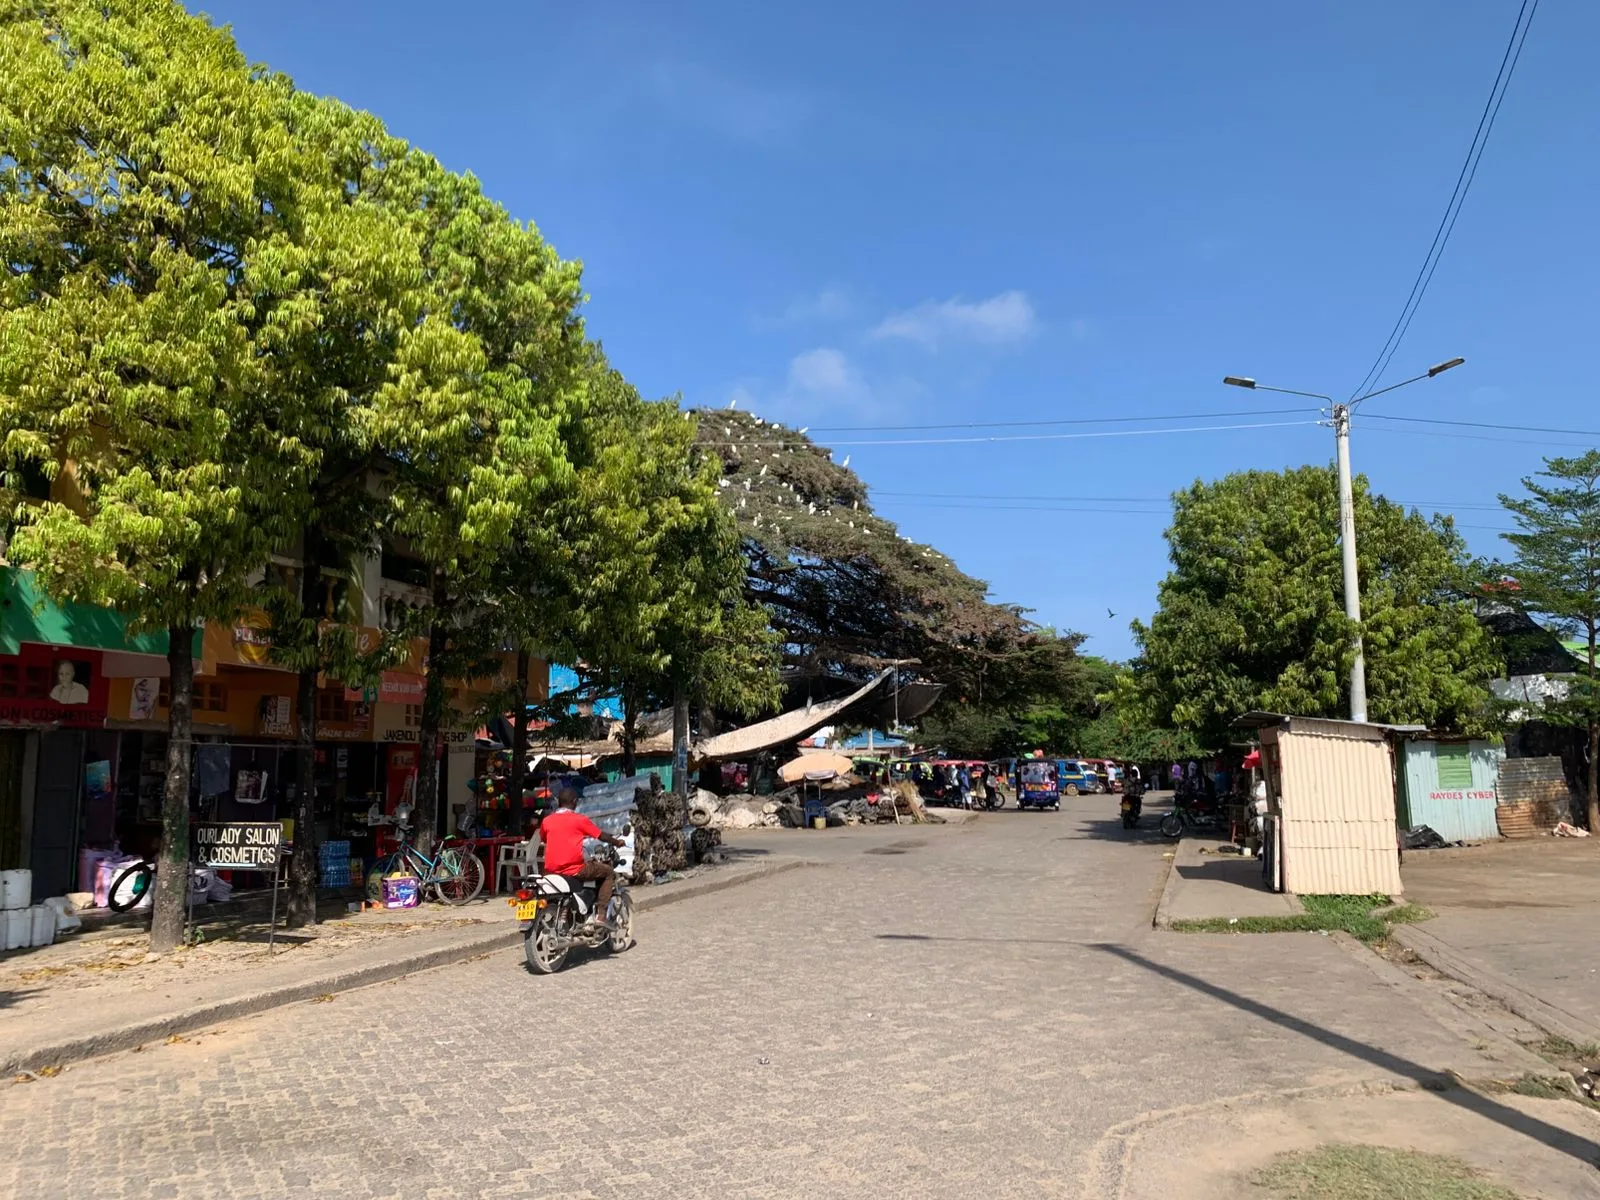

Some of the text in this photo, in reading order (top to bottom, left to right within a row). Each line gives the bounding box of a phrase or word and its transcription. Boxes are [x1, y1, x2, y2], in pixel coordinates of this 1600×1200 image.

[245, 828, 280, 845] SALON
[198, 846, 276, 863] & COSMETICS
